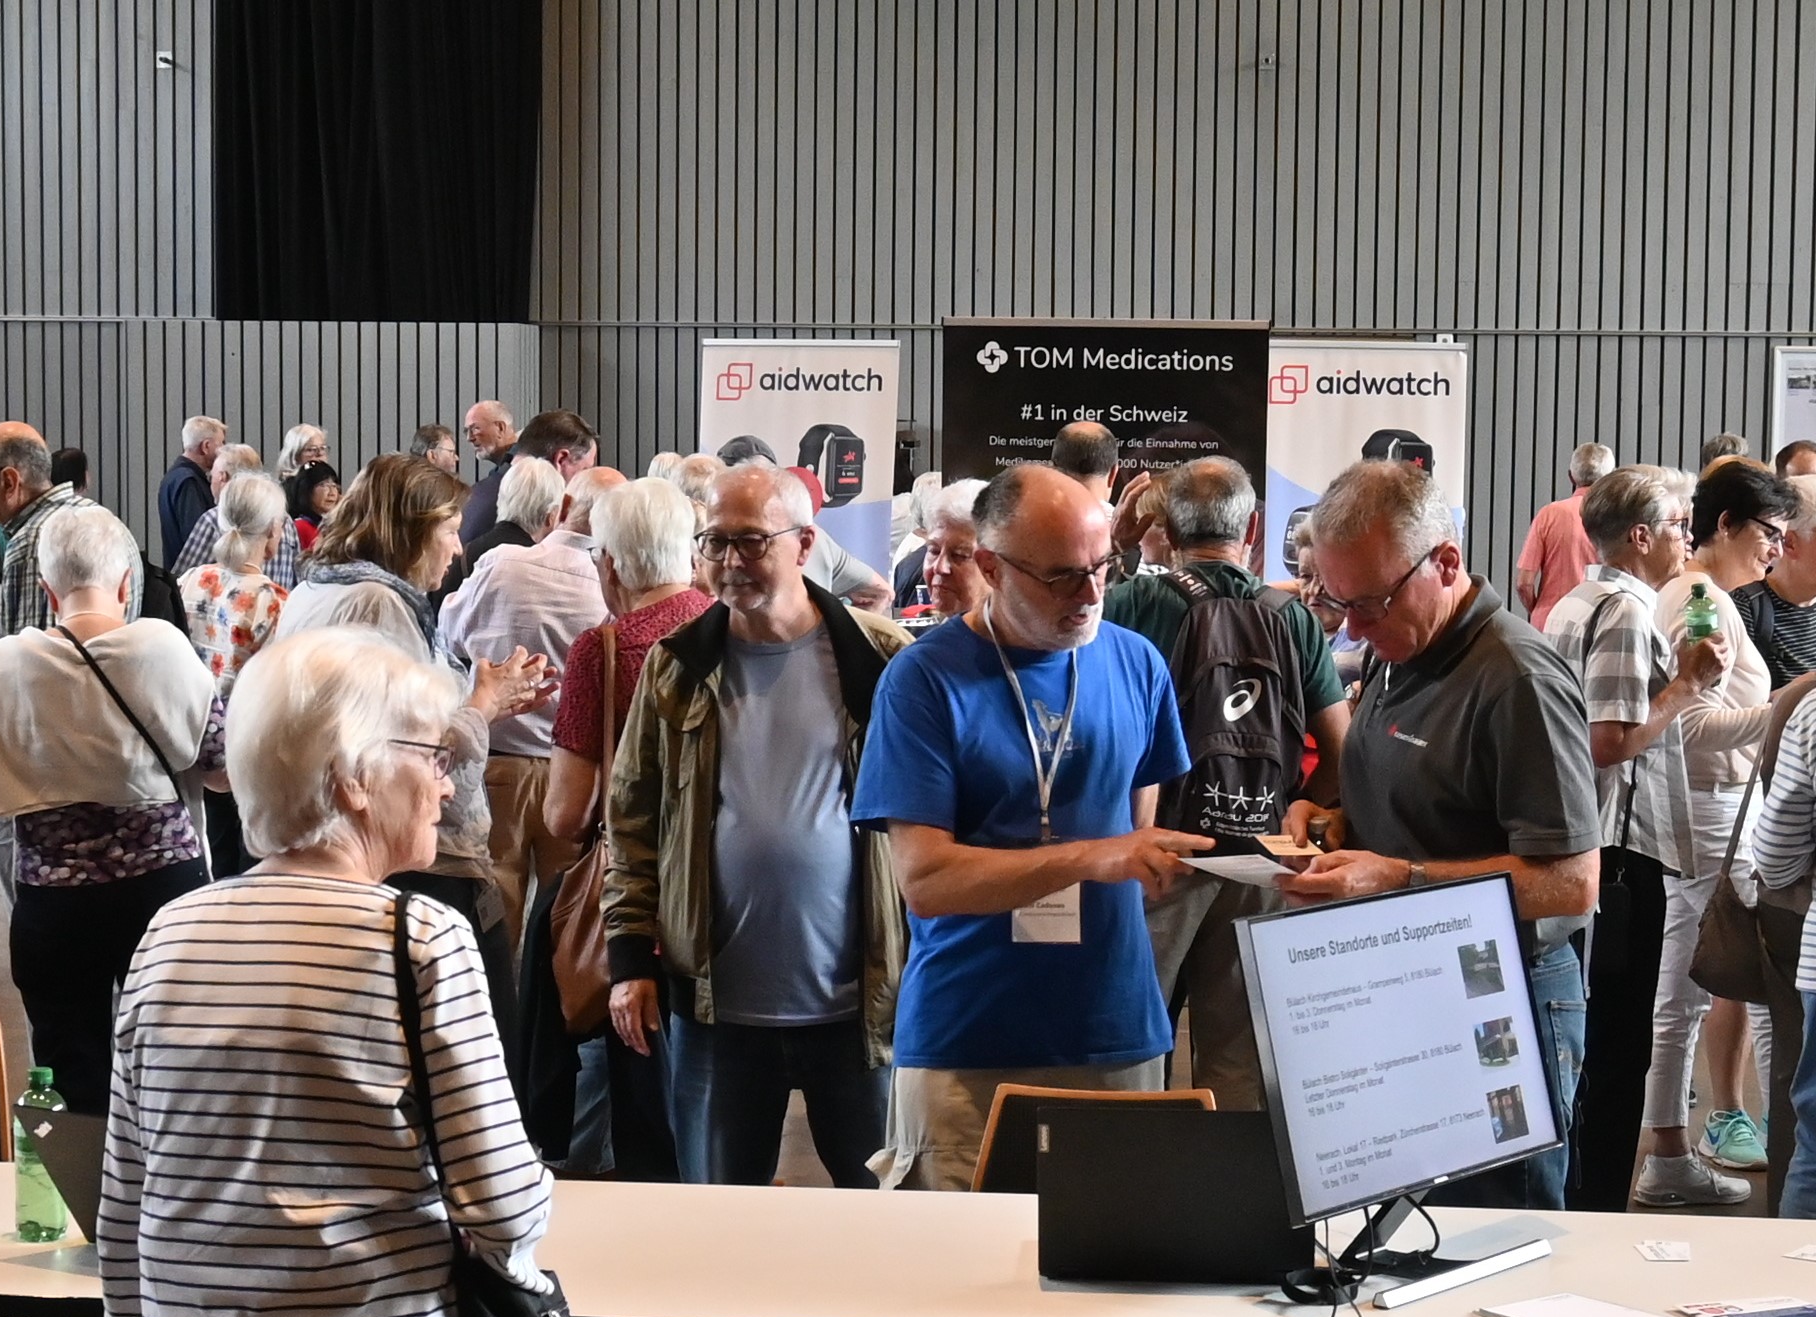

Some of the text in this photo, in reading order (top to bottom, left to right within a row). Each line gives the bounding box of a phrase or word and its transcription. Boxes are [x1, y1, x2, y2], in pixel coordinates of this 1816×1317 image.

[1013, 346, 1235, 373] TOM Medications
[758, 366, 884, 392] aidwatch
[1315, 369, 1451, 397] aidwatch
[1019, 404, 1189, 424] #1 in der Schweiz
[988, 435, 1007, 447] Die
[1009, 435, 1055, 450] meistge
[1128, 437, 1144, 449] die
[1145, 437, 1198, 449] Einnahme
[1199, 439, 1220, 451] von
[1117, 458, 1138, 470] 000
[1140, 458, 1185, 471] Nutzeri
[1201, 806, 1242, 822] Aarau
[1287, 914, 1473, 965] Unsere Standorte und Supportzeiten!
